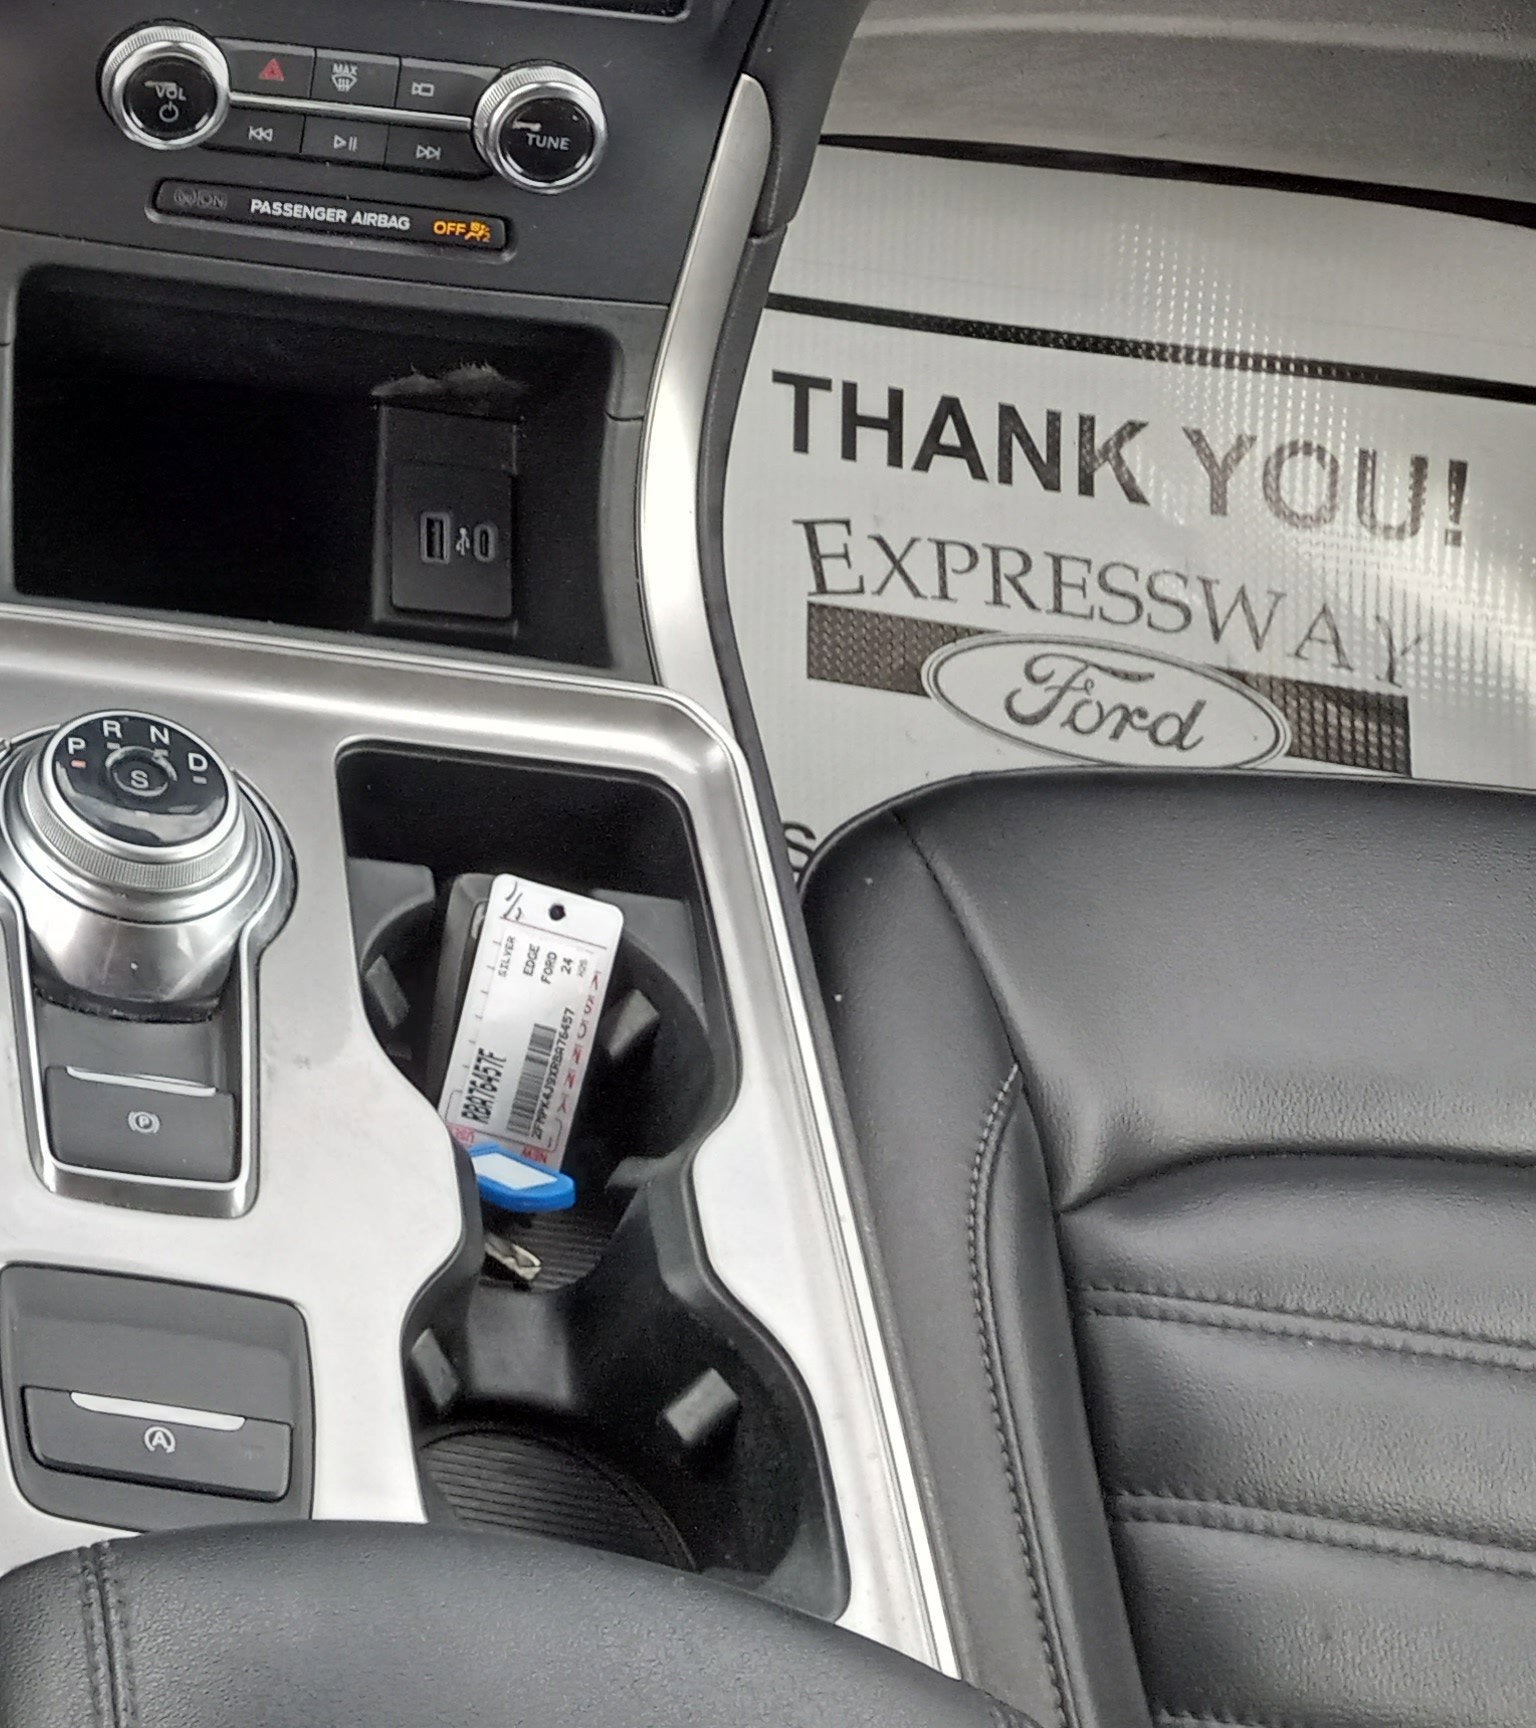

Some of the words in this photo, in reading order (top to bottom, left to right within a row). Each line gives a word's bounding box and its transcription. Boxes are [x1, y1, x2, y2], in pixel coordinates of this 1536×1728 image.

[332, 63, 358, 76] MAX
[154, 84, 186, 102] VOL
[526, 132, 571, 152] TUNE
[250, 198, 347, 225] PASSENGER
[351, 210, 410, 232] AIRBAG
[433, 220, 467, 236] OFF
[771, 368, 1150, 507] THANK
[1180, 424, 1469, 547] YOU!
[1003, 652, 1206, 754] Ford
[68, 737, 86, 755] P
[103, 720, 122, 739] R
[150, 726, 171, 745] N
[188, 752, 208, 772] D
[130, 770, 148, 788] S
[497, 935, 517, 978] SILVER
[522, 942, 541, 978] EDGE
[540, 951, 558, 985] FORD
[560, 957, 574, 976] 24
